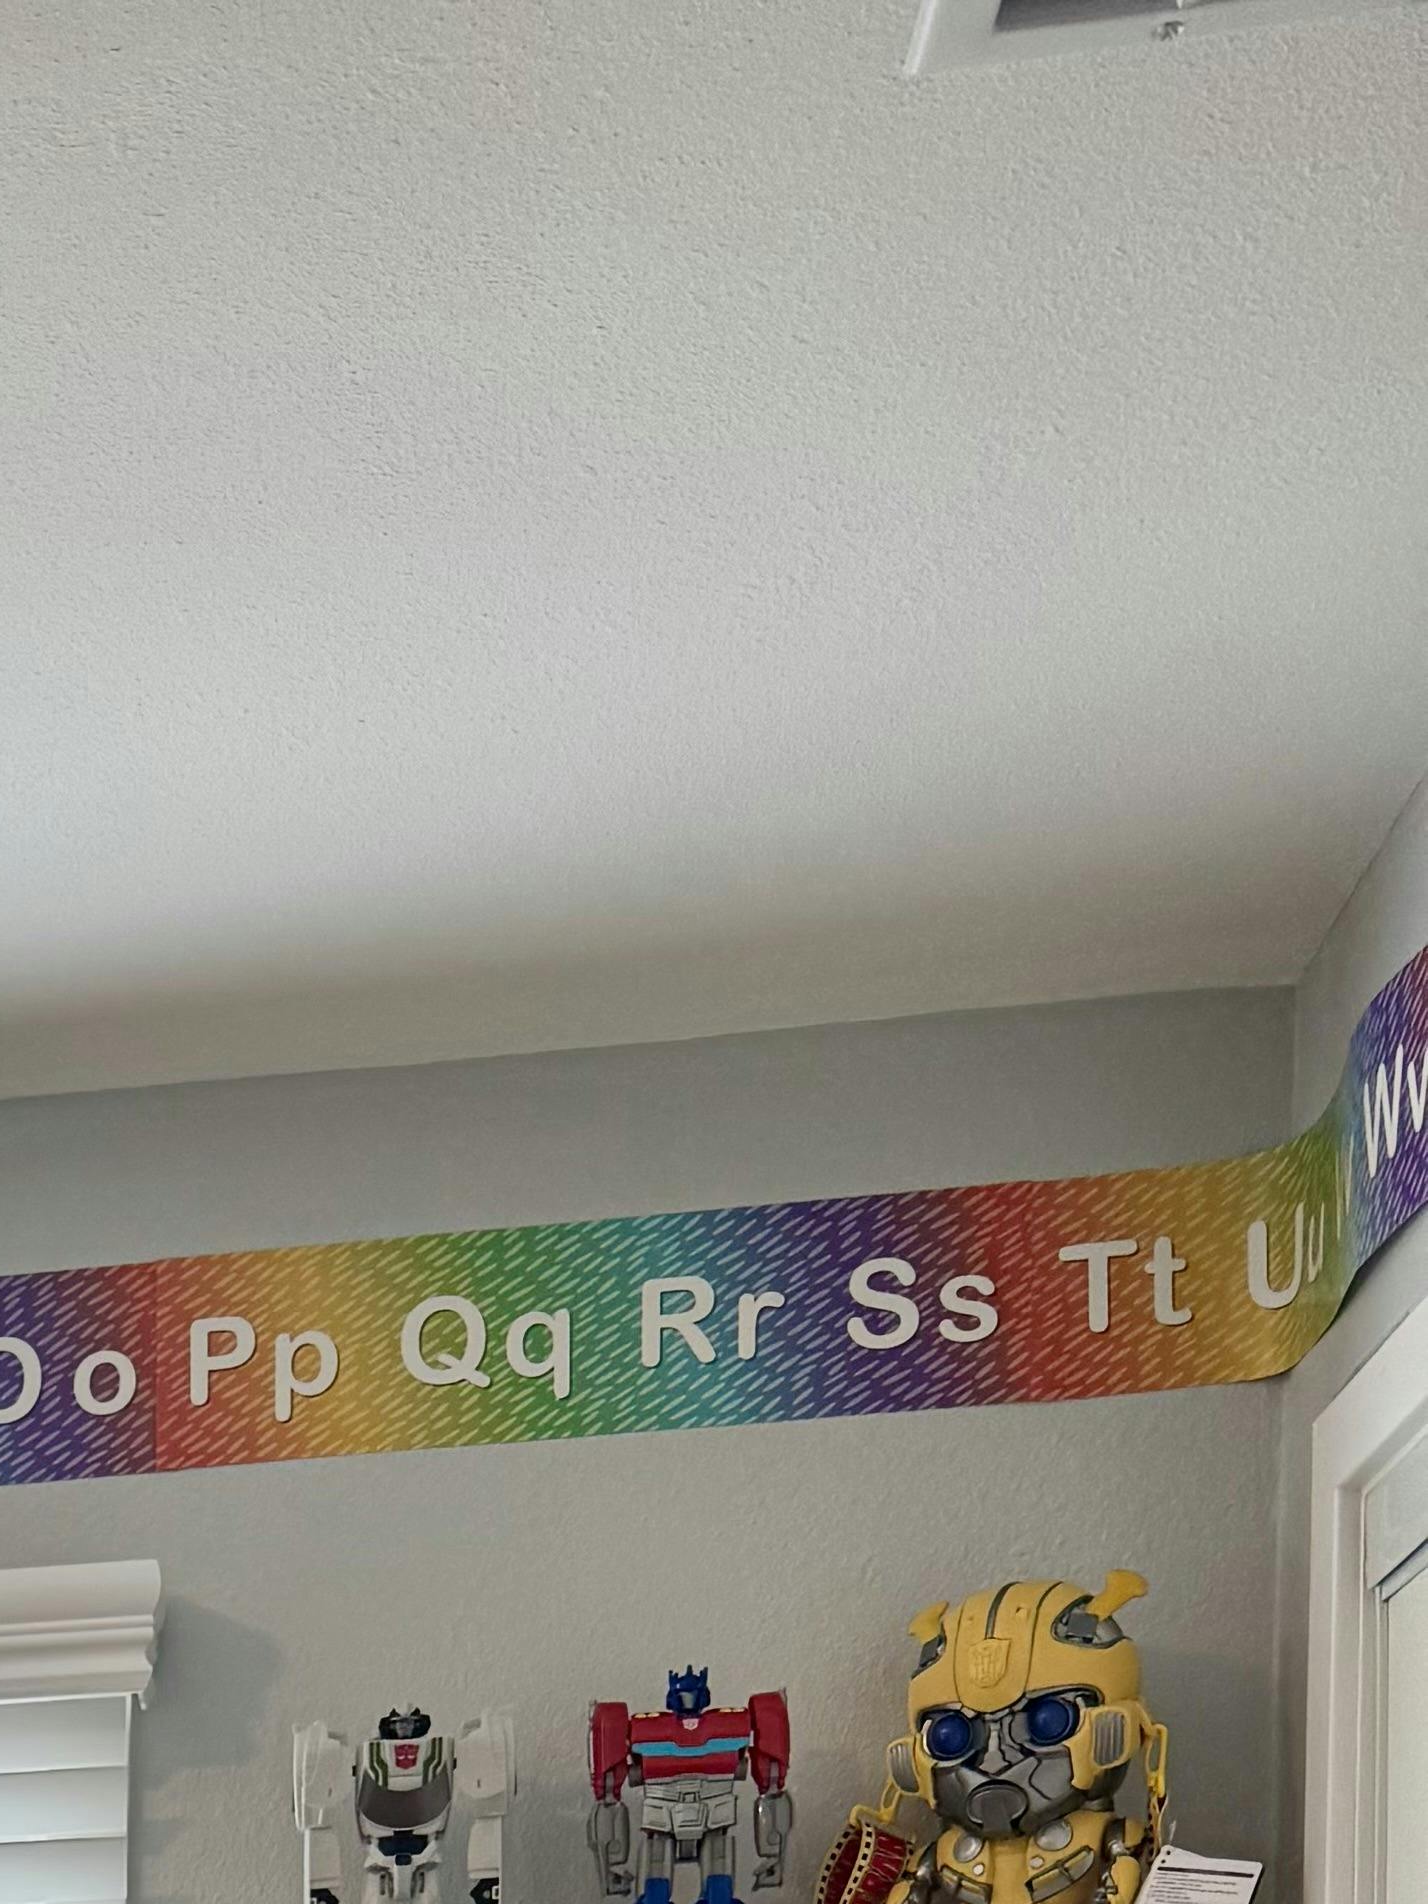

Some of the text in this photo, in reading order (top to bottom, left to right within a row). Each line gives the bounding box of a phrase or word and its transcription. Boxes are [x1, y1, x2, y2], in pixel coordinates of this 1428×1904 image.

[190, 1317, 337, 1420] Pp
[401, 1296, 570, 1398] Qq
[640, 1276, 784, 1367] Rr
[848, 1258, 997, 1348] Ss
[1060, 1238, 1188, 1331] Tt
